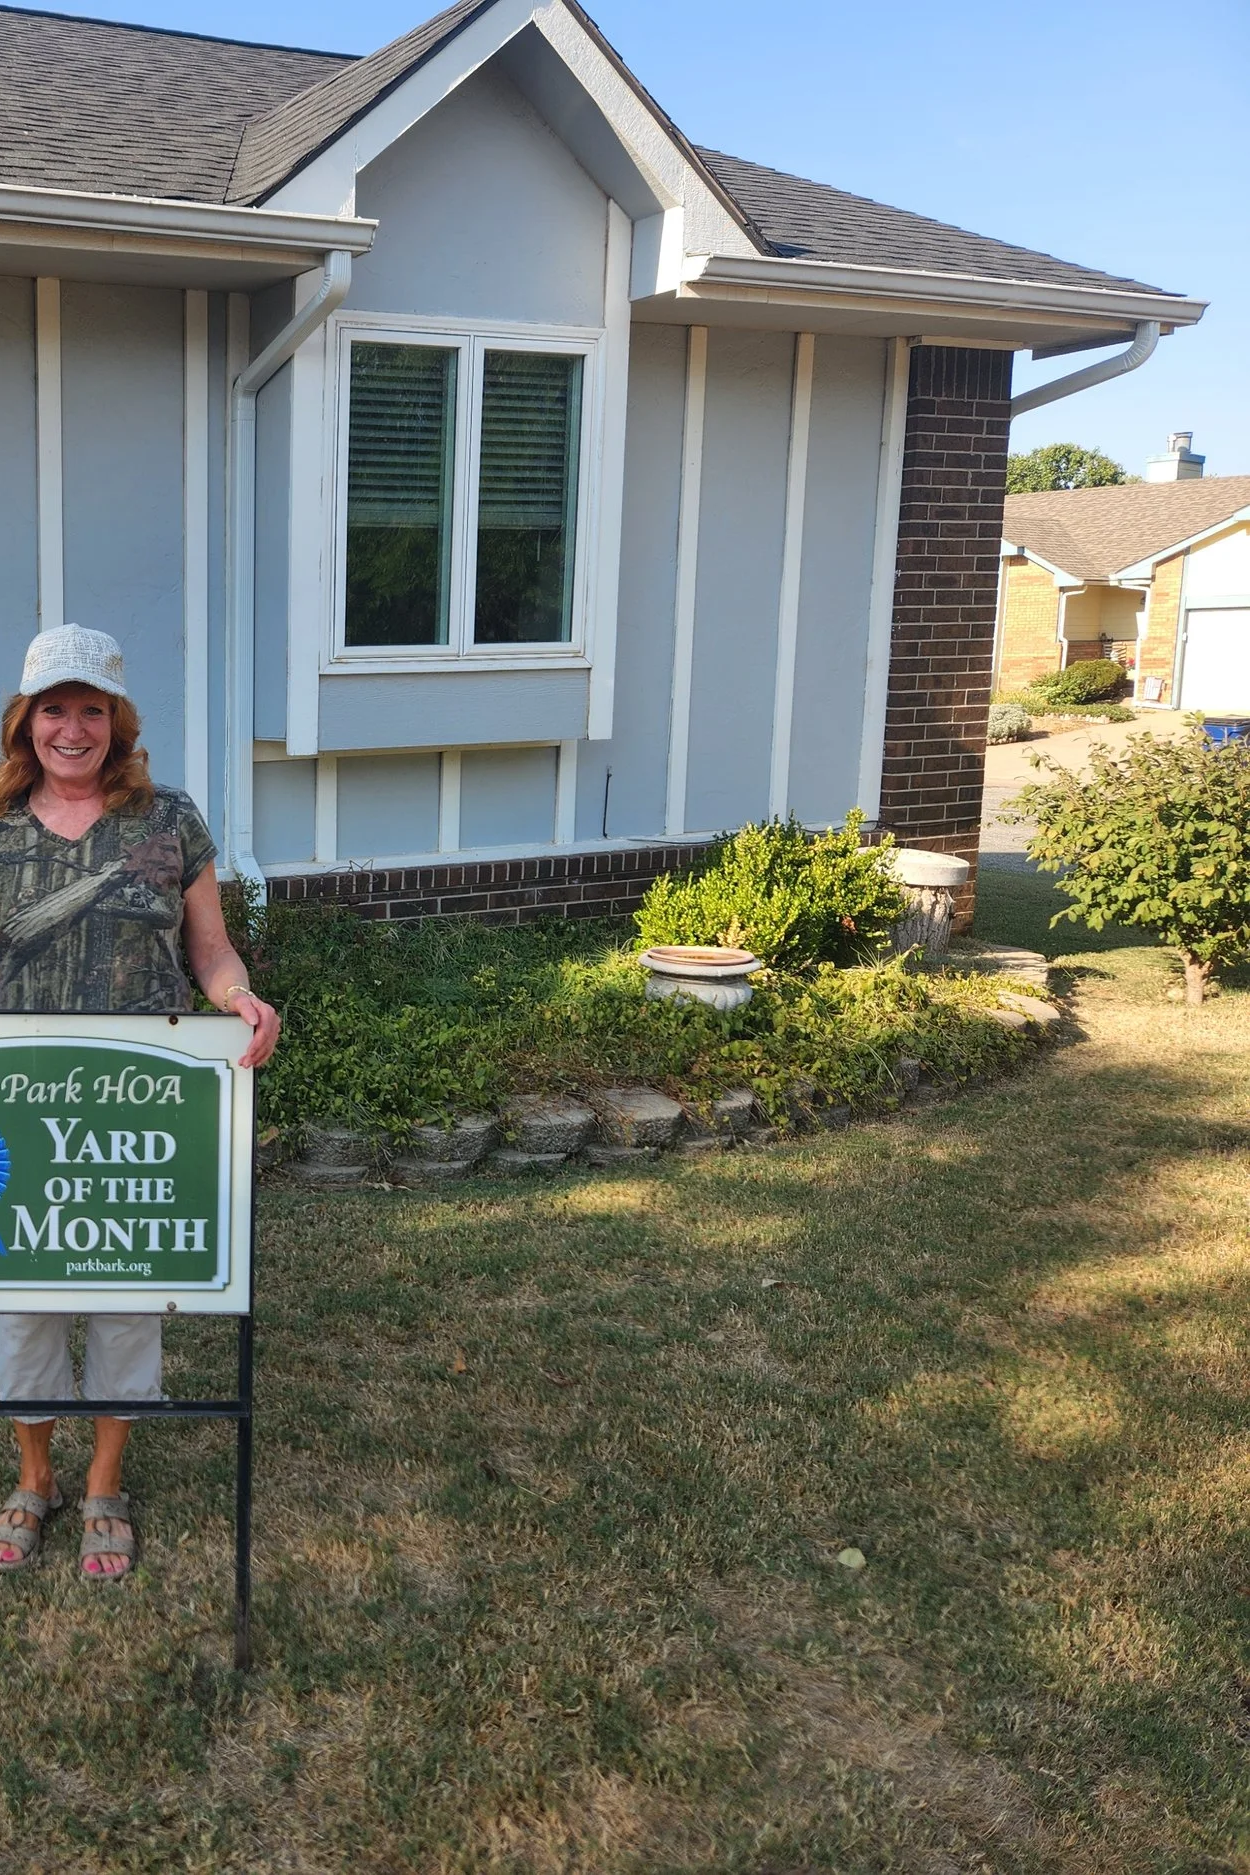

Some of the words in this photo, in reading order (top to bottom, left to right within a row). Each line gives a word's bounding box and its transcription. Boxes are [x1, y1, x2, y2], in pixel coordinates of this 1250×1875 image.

[0, 1067, 84, 1104] Park
[93, 1066, 185, 1105] HOA
[44, 1177, 93, 1204] OF
[100, 1177, 176, 1204] THE
[65, 1258, 152, 1277] parkbark.org
